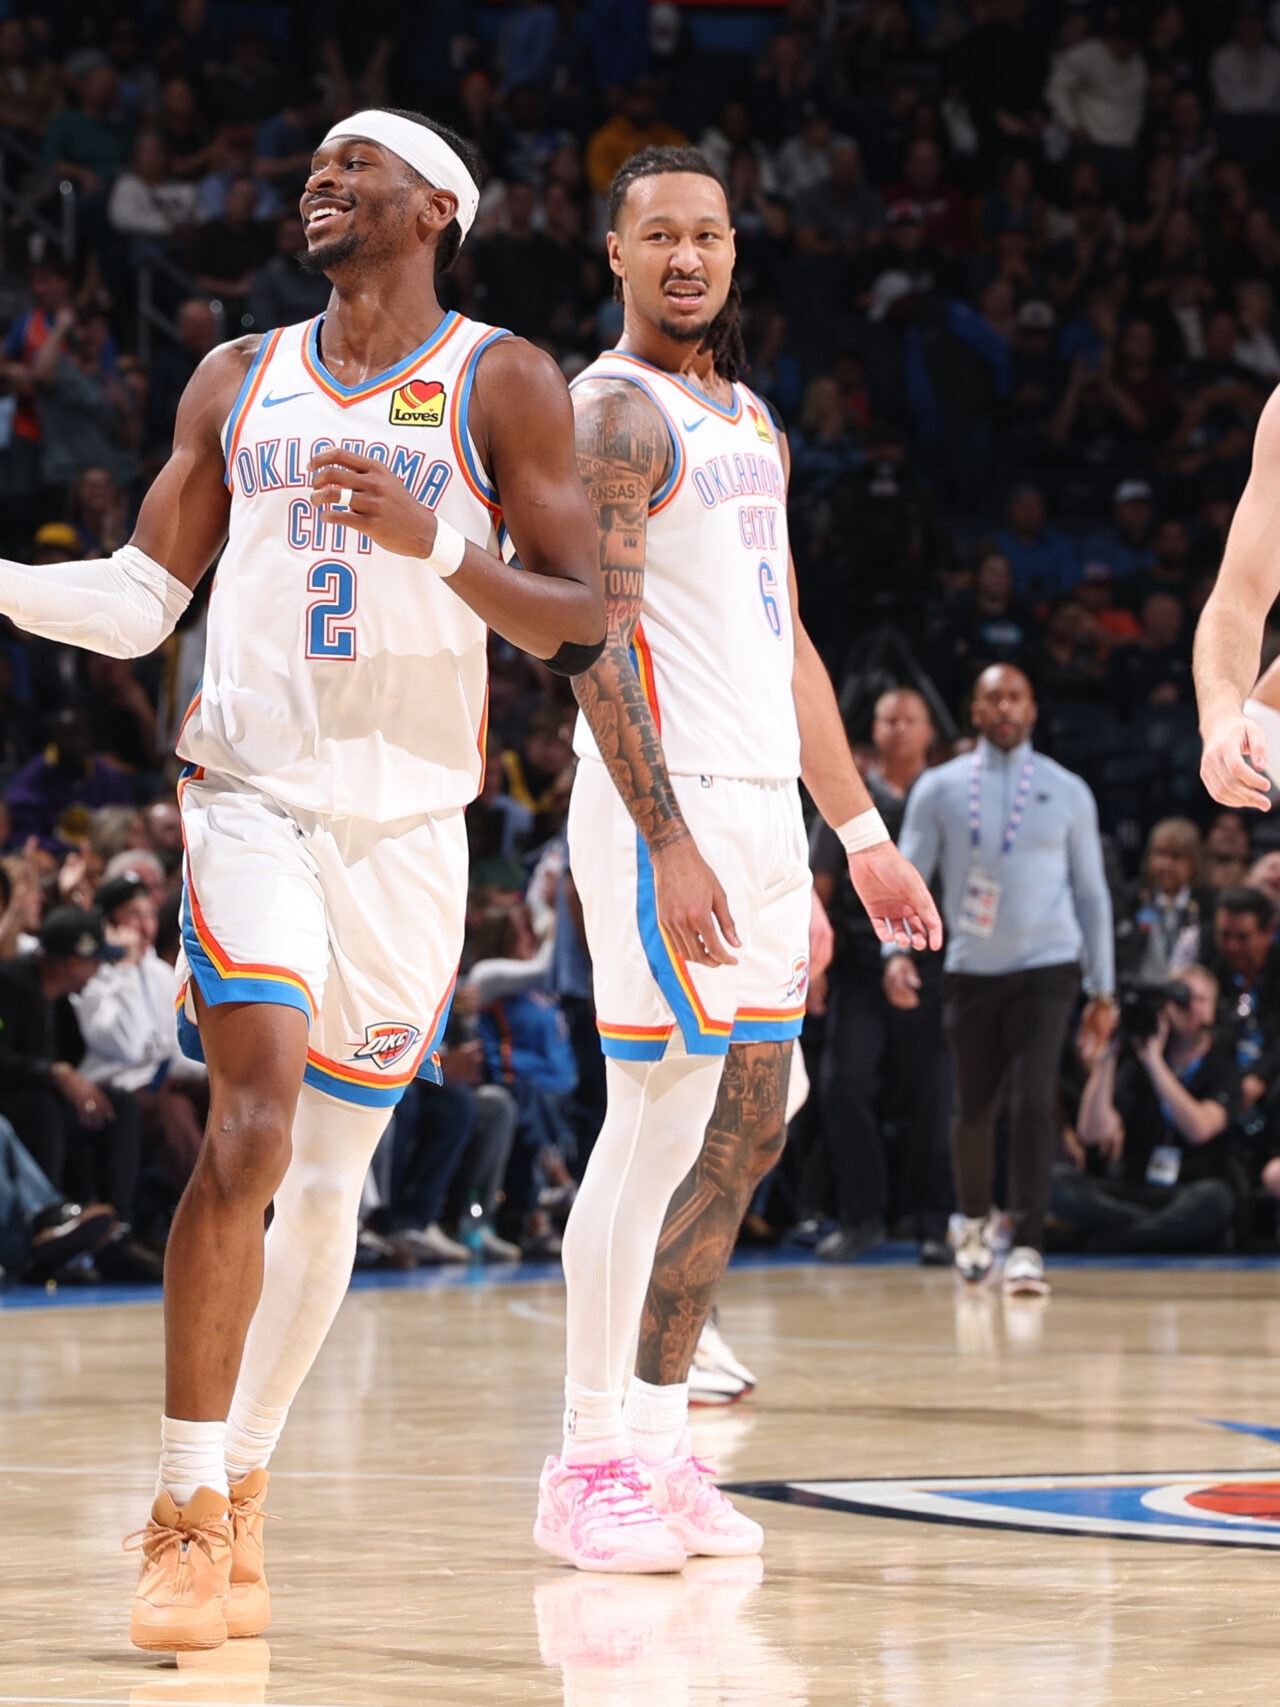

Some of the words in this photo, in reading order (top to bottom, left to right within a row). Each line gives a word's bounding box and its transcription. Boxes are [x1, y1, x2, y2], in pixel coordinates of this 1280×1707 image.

[738, 505, 779, 551] CITY
[305, 558, 358, 662] 2
[757, 556, 784, 642] 6
[353, 1032, 409, 1058] OKC
